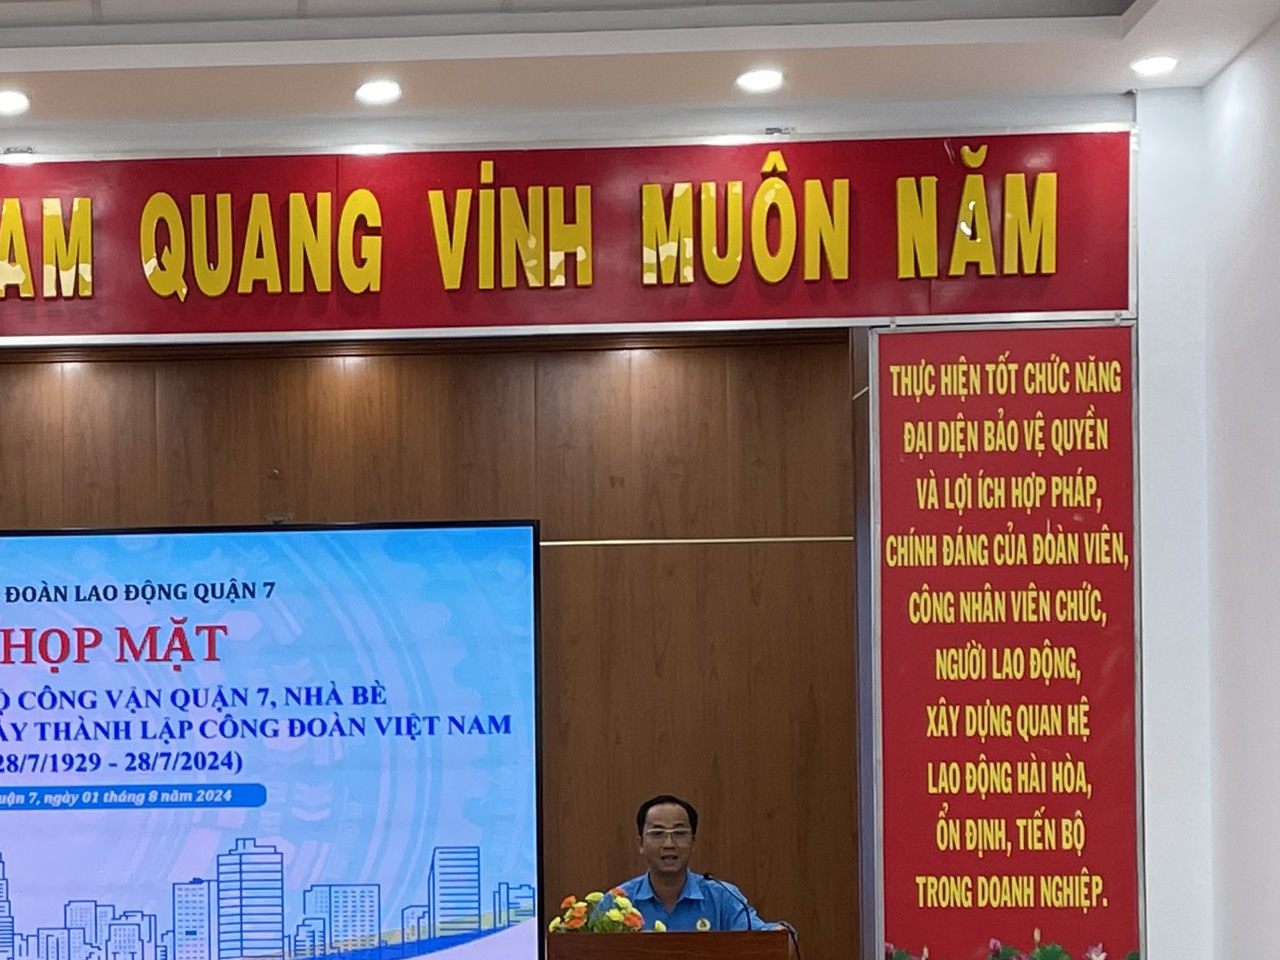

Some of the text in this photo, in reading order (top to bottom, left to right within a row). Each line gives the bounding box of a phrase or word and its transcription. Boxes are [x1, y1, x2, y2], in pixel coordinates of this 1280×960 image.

[140, 188, 382, 302] QUANG
[641, 150, 849, 286] MUÔN
[896, 144, 1057, 279] NĂM
[890, 351, 1121, 402] THỰC HIỆN TỐT CHỨC NĂNG
[904, 405, 1108, 459] ĐẠI DIỆN BẢO VỆ QUYỀN
[917, 467, 1101, 515] VÀ LỢI ÍCH HỢP PHÁP,
[886, 521, 1128, 570] CHÍNH ĐÁNG CỦA ĐOÀN VIÊN,
[5, 580, 68, 603] ĐOÀN
[75, 583, 118, 602] LAO
[124, 579, 188, 605] ĐỘNG
[194, 577, 256, 604] QUẬN
[263, 581, 276, 600] 7
[909, 581, 1106, 627] CÔNG NHÂN VIÊN CHỨC,
[0, 616, 228, 674] HỌP MẶT
[936, 639, 1080, 685] NGƯỜI LAO ĐỘNG,
[18, 685, 98, 711] CÔNG
[256, 688, 277, 709] 7,
[284, 681, 344, 707] NHÀ
[352, 680, 388, 706] BÈ
[34, 716, 132, 741] THÀNH
[199, 714, 280, 739] CÔNG
[288, 712, 366, 737] ĐOÀN
[374, 713, 441, 741] VIỆT
[447, 714, 512, 736] NAM
[927, 696, 1090, 743] XÂY DỰNG QUAN HỆ
[124, 751, 244, 775] 28/7/2024)
[928, 753, 1091, 800] LAO ĐỘNG HÀI HÒA,
[28, 791, 41, 806] 7,
[44, 790, 80, 806] ngày
[82, 791, 99, 803] 01
[103, 790, 145, 806] tháng
[148, 790, 158, 802] 8
[161, 789, 193, 803] năm
[196, 789, 233, 802] 2024
[937, 802, 1085, 857] ỔN ĐỊNH, TIẾN BỘ
[916, 867, 1107, 913] TRONG DOANH NGHIỆP.
